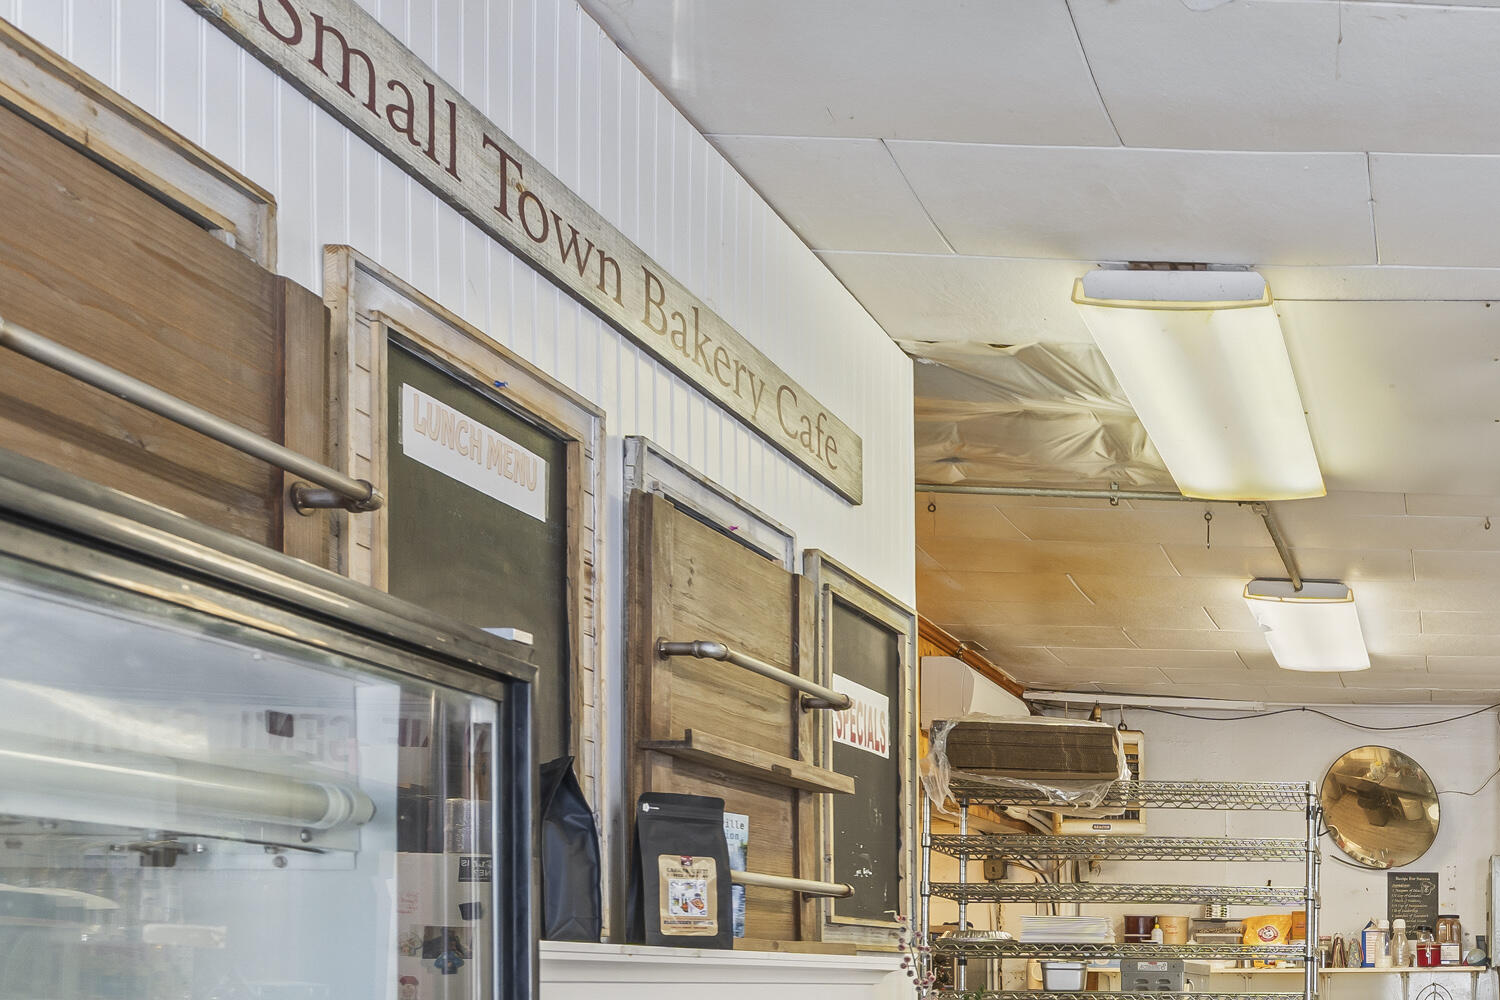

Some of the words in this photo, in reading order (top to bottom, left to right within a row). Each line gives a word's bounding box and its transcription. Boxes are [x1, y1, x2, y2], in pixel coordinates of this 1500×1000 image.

[483, 133, 625, 308] Town
[641, 265, 766, 422] Bakery
[776, 385, 838, 471] Cafe
[413, 393, 482, 465] LUNCH
[487, 434, 538, 491] MENU
[836, 698, 886, 754] SPECIALS
